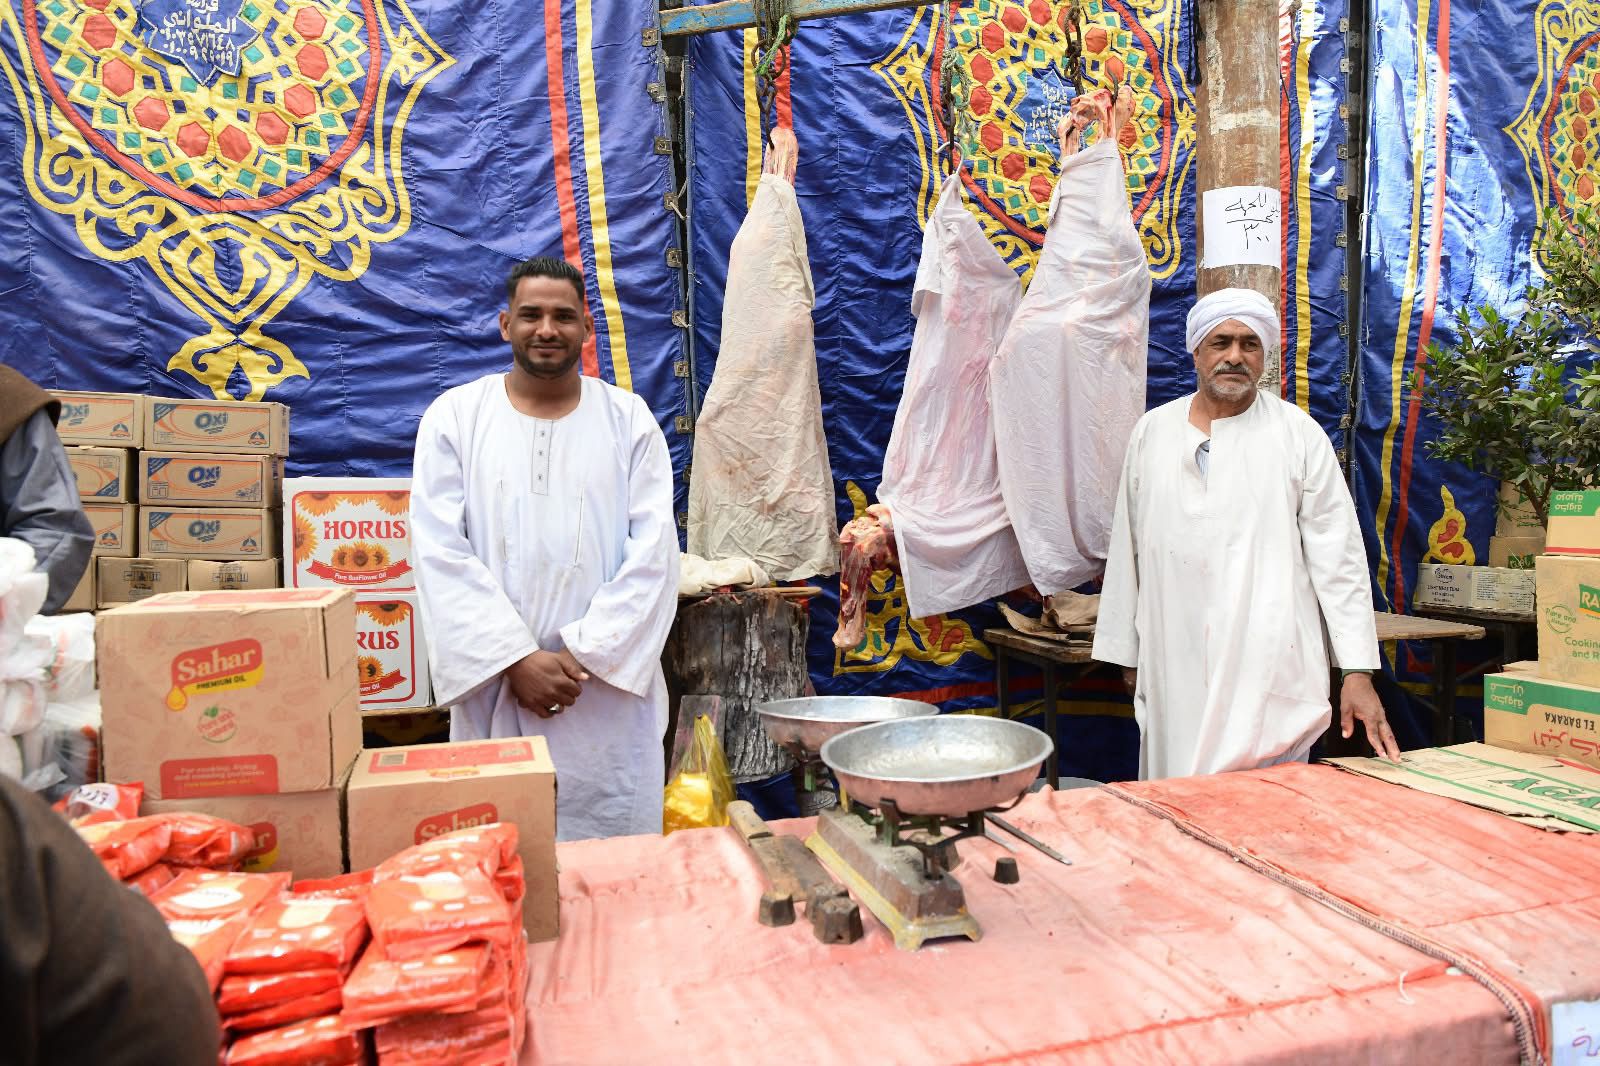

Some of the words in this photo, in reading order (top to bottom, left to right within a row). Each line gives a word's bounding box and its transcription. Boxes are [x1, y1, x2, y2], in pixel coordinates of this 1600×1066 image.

[194, 412, 229, 430] Oxi
[188, 465, 221, 484] Oxi
[188, 520, 221, 538] Oxi
[323, 520, 407, 540] HORUS
[356, 630, 400, 650] RUS
[1564, 636, 1600, 649] Cookin
[1572, 650, 1590, 659] and
[177, 647, 256, 682] Sahar
[195, 678, 233, 690] PREMIUM
[1544, 711, 1581, 729] BARAKA
[1584, 720, 1595, 731] EL
